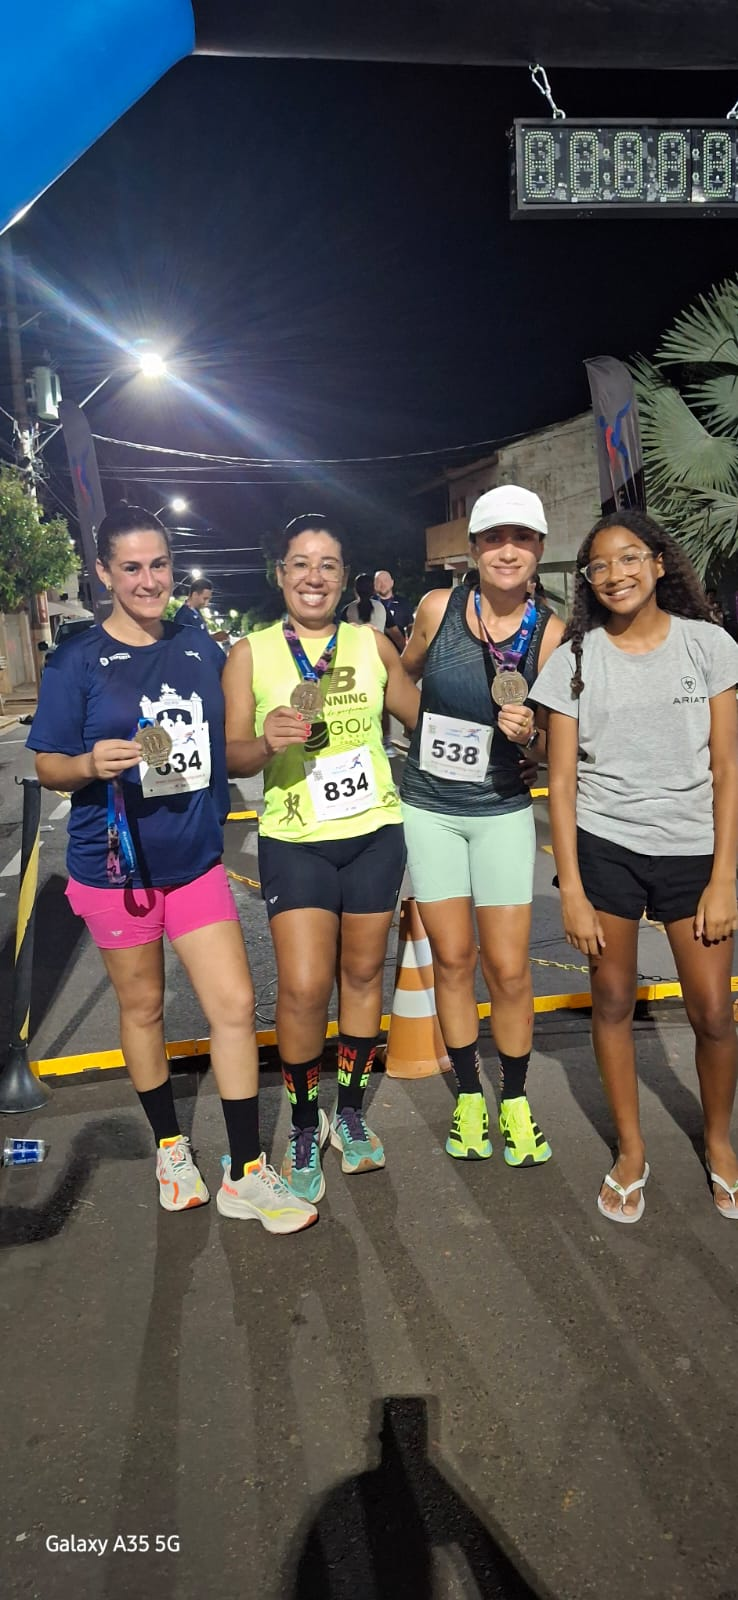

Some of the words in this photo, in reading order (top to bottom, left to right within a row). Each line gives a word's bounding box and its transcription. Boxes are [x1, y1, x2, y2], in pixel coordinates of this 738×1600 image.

[324, 692, 368, 707] NNING
[673, 696, 707, 704] ARIAT
[431, 738, 479, 765] 538
[324, 772, 369, 801] 834
